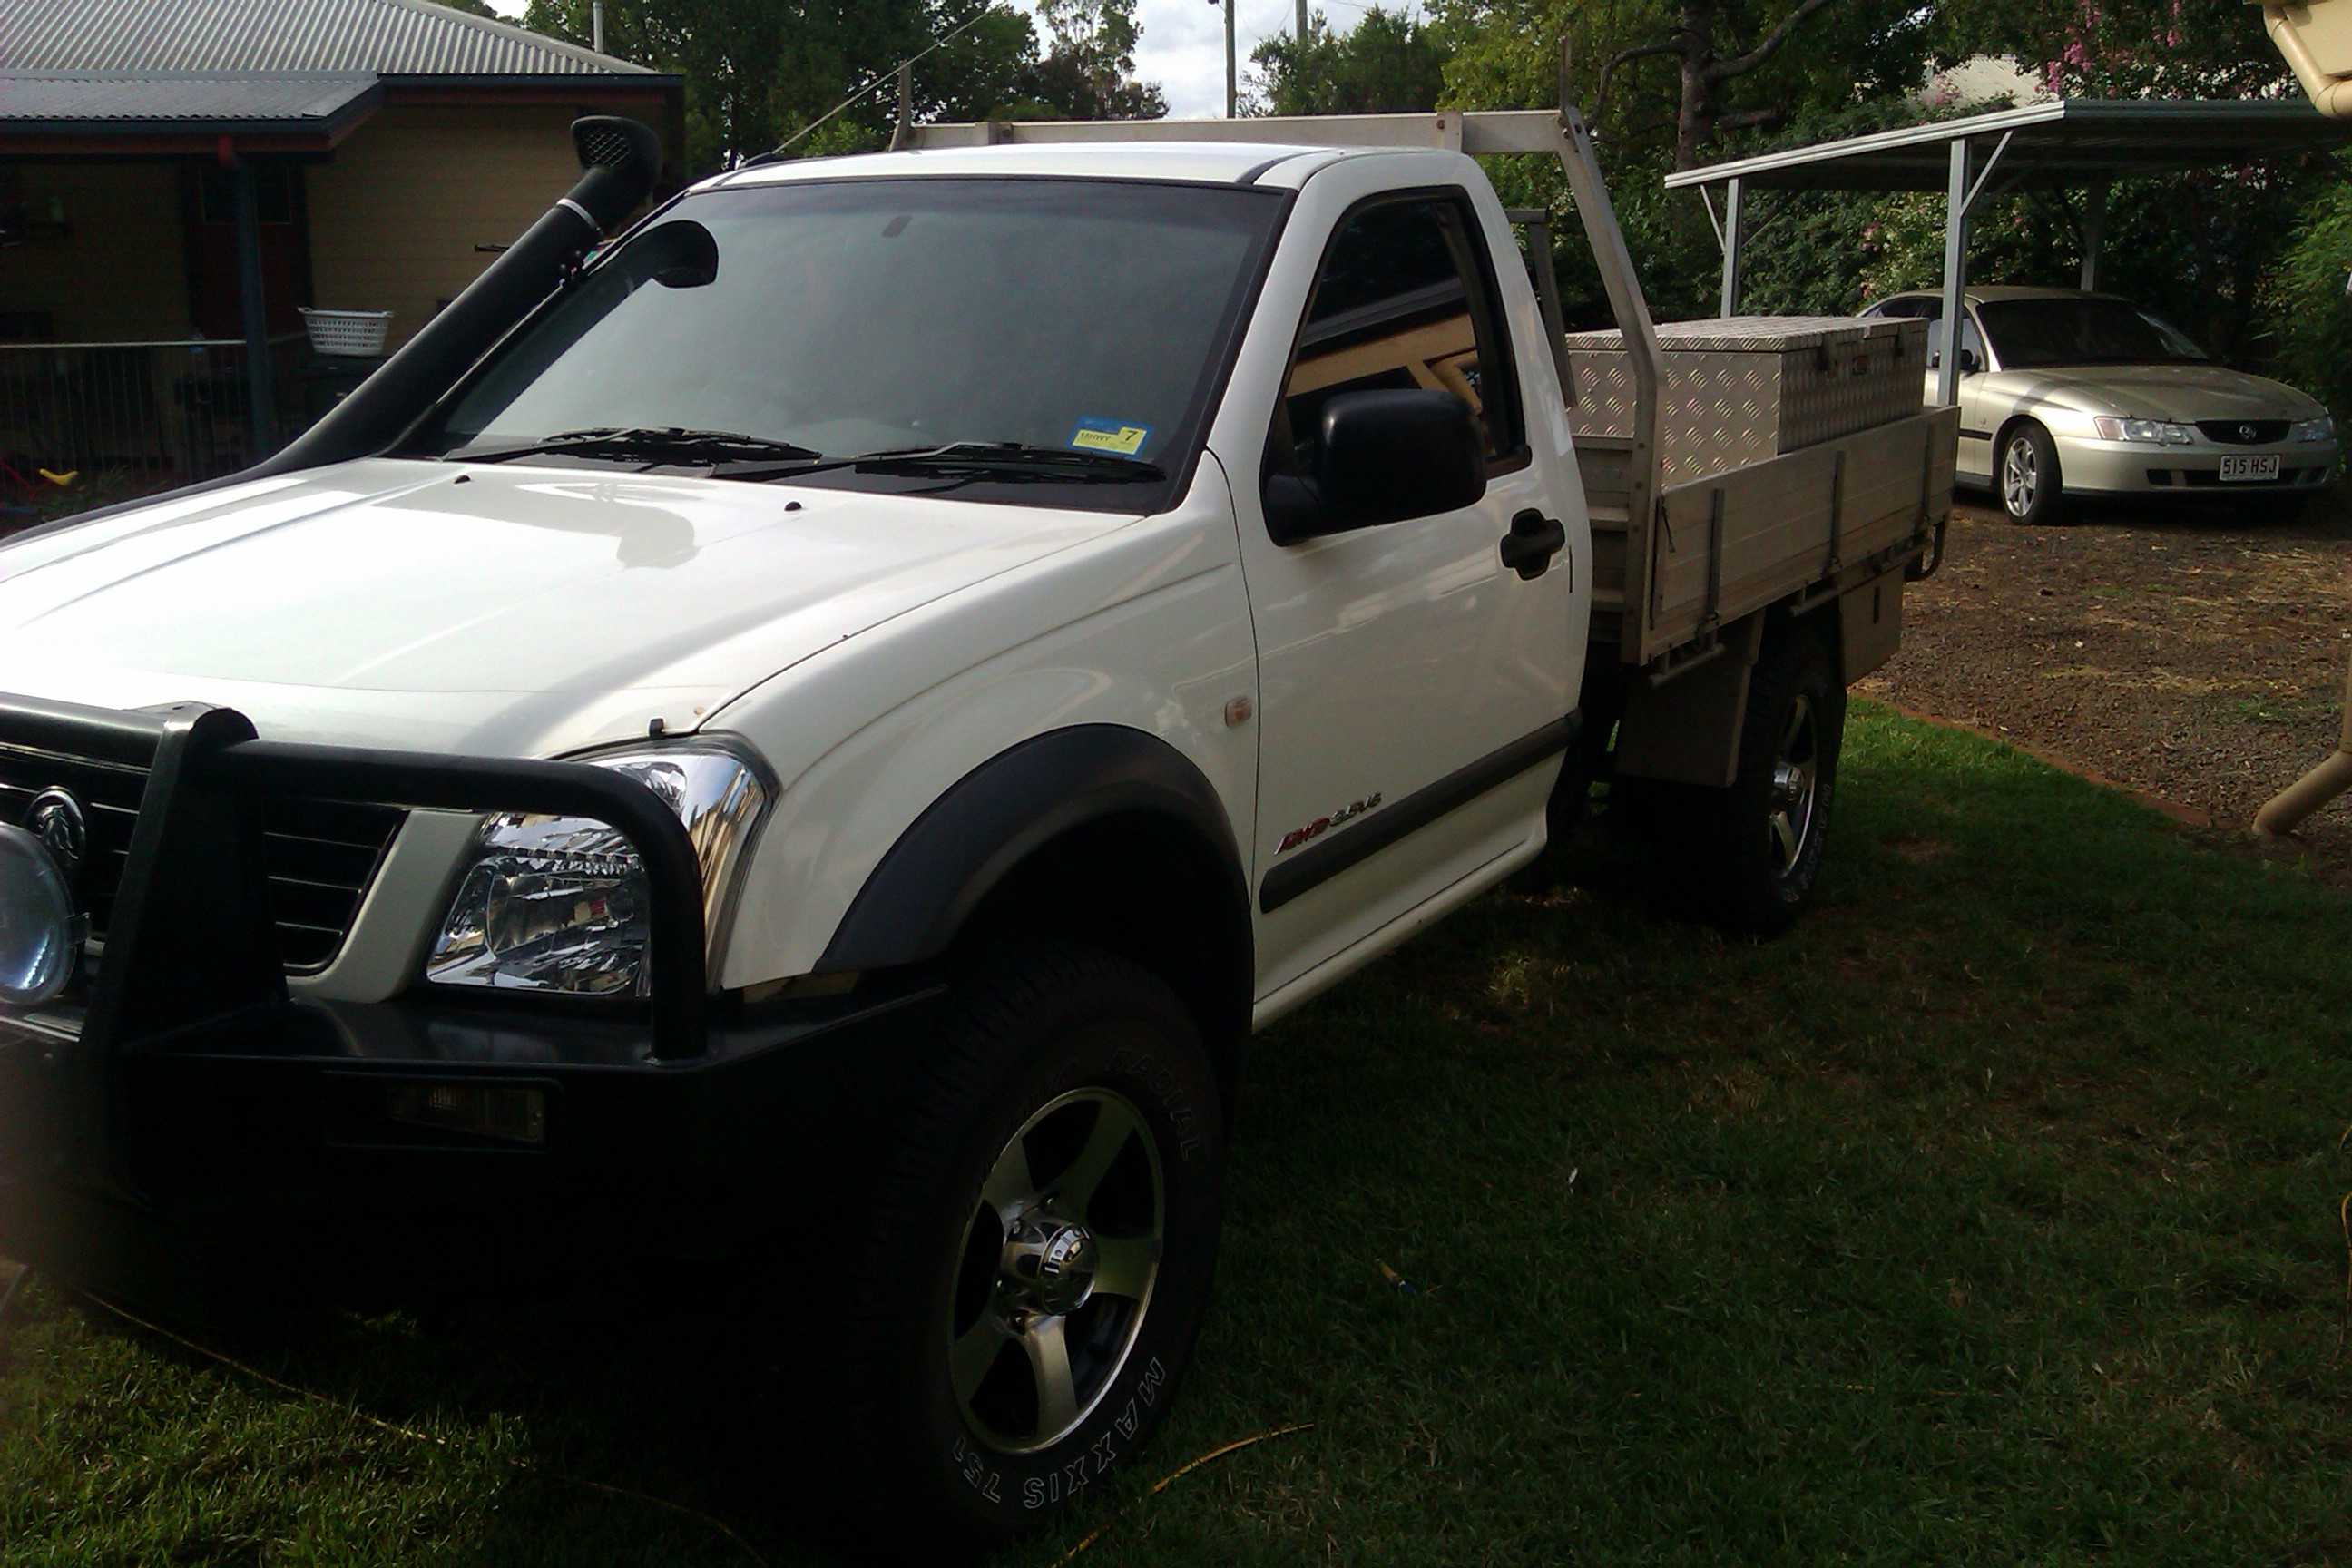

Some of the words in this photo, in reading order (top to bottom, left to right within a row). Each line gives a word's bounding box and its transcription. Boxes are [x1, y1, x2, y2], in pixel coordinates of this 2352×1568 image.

[1125, 430, 1138, 441] 7
[2224, 458, 2247, 474] 515
[2251, 458, 2277, 473] HSJ
[1104, 1049, 1201, 1161] RADIAL
[1022, 1357, 1166, 1509] MAXXIS
